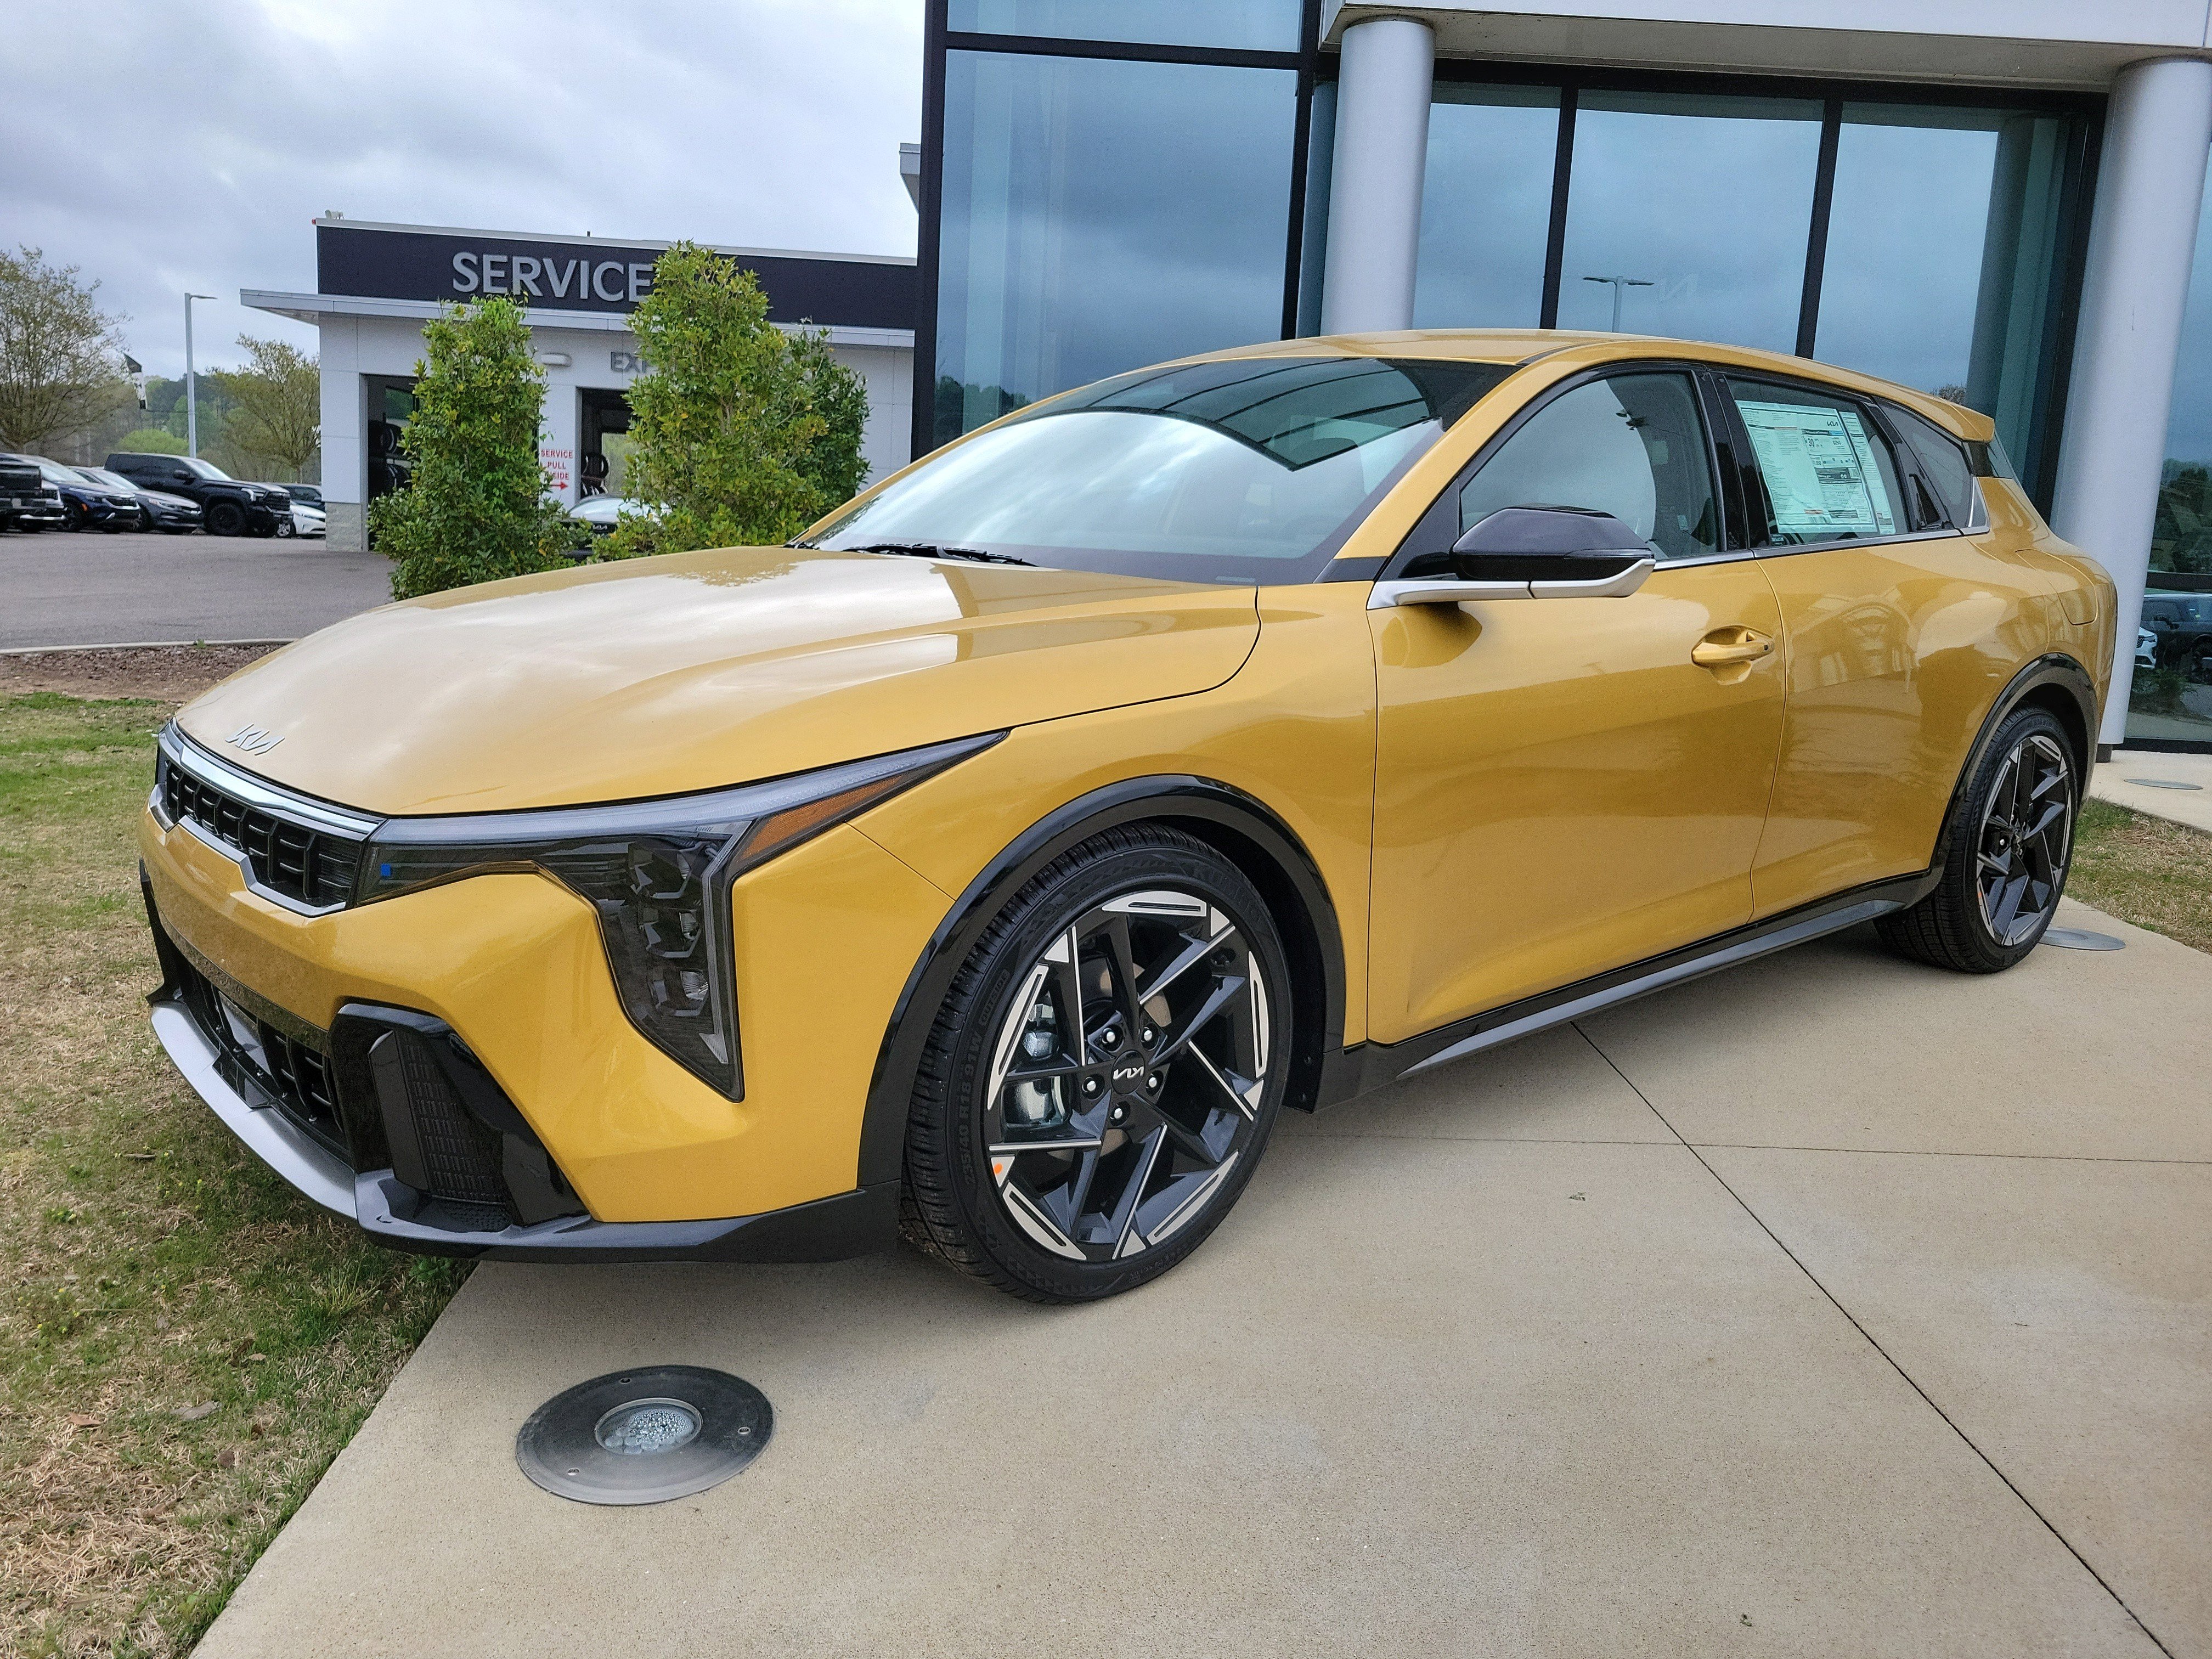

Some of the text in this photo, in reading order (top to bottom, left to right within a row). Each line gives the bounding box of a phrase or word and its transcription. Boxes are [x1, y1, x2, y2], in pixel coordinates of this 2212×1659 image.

[453, 252, 653, 302] SERVICE
[541, 449, 573, 459] SERVICE
[544, 471, 569, 481] SIDE
[548, 461, 566, 470] PULL
[225, 723, 285, 756] KIA
[980, 969, 1009, 1024] OUTSIDE
